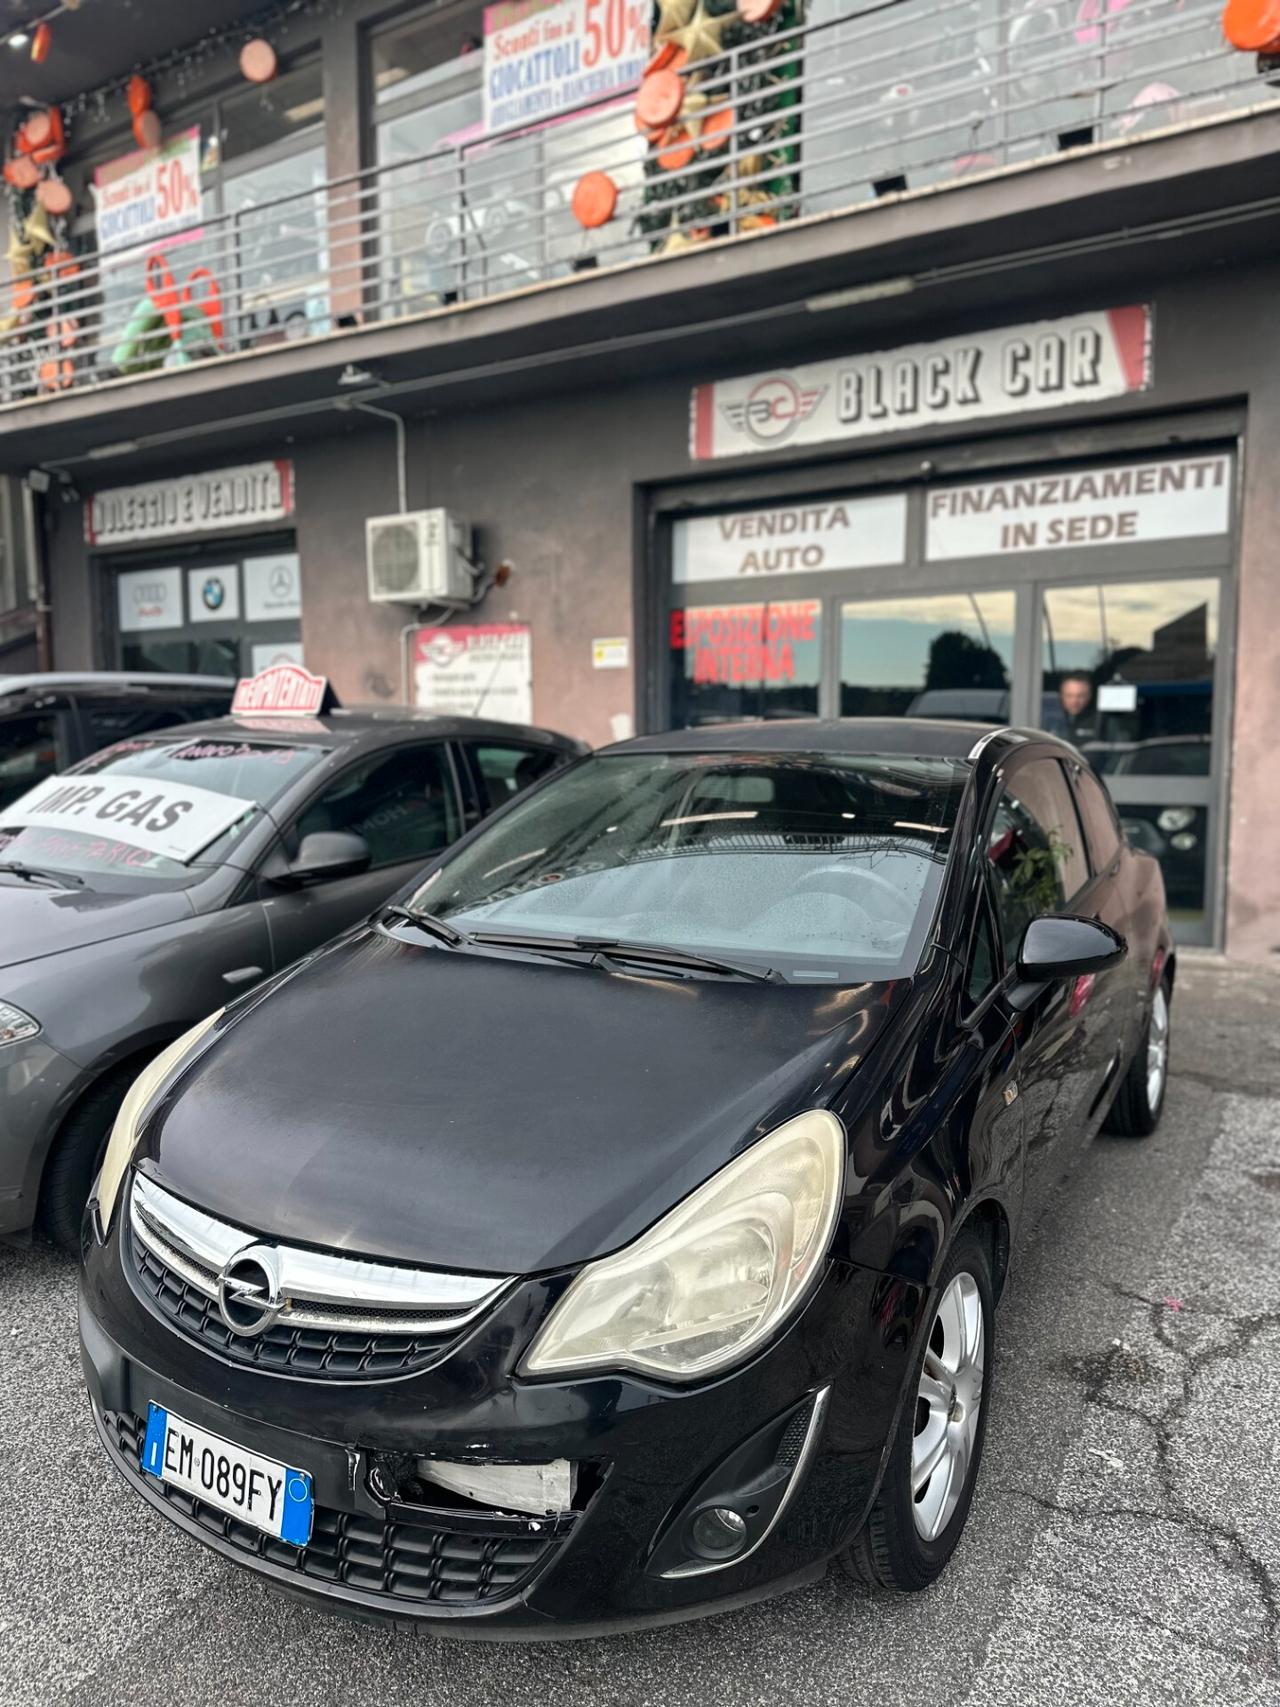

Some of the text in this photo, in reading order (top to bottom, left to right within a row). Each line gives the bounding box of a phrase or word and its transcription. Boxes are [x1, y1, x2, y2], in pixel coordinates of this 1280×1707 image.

[582, 0, 649, 67] 50%
[157, 159, 197, 219] 50%
[838, 346, 982, 423] BLACK
[1003, 326, 1101, 396] CAR
[931, 460, 1225, 518] FINANZIAMENTI
[717, 506, 851, 541] VENDITA
[1001, 511, 1139, 548] IN SEDE
[740, 545, 825, 574] AUTO
[670, 601, 817, 649] ESPOSIZIONE
[693, 642, 795, 684] INTERNA
[28, 785, 194, 832] IMP. GAS
